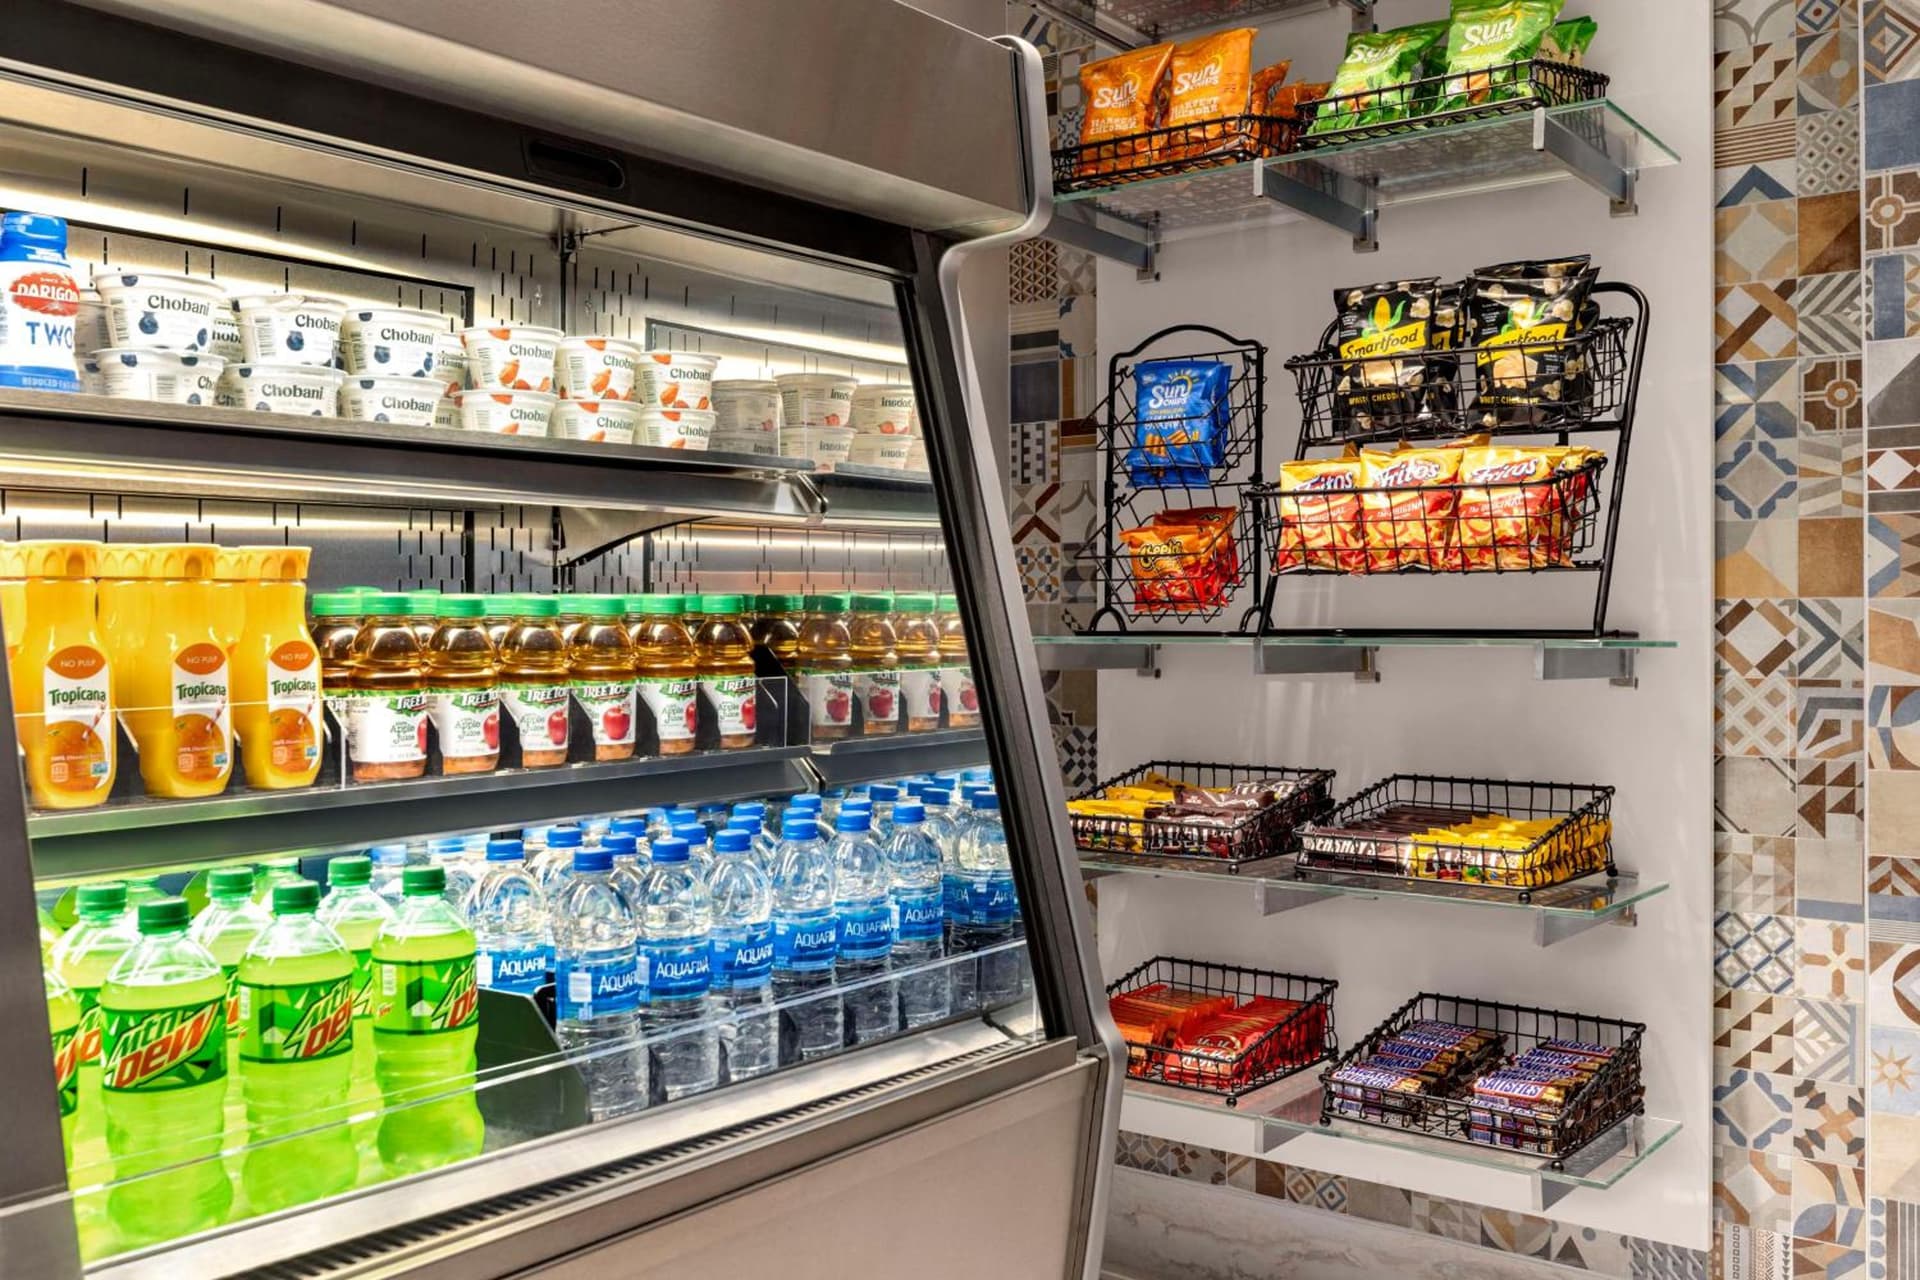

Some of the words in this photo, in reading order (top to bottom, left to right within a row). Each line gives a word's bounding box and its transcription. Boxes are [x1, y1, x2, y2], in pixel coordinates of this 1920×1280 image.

[1462, 18, 1515, 51] Sun
[1173, 61, 1222, 95] Sun
[1093, 80, 1139, 108] Sun
[16, 284, 80, 302] DARIGO
[147, 294, 210, 316] Chobani
[294, 313, 340, 332] Choba
[380, 327, 435, 346] Chobani
[1344, 328, 1419, 360] Smartfood
[602, 354, 635, 369] Choba
[261, 383, 324, 401] Chobani
[1148, 382, 1190, 409] Sun
[1371, 391, 1406, 403] CHEDDR
[381, 395, 435, 413] Chobani
[509, 407, 548, 423] Choba
[596, 416, 635, 431] Choban
[1373, 459, 1441, 488] Fritos
[1471, 457, 1539, 483] Fritos
[61, 659, 75, 668] NO
[78, 659, 96, 667] PULP
[48, 685, 107, 706] Tropicana
[176, 681, 227, 701] Tropicana
[271, 677, 316, 696] Tropicana
[527, 688, 553, 702] TREE
[582, 687, 608, 699] TREE
[389, 722, 416, 736] Apple
[455, 719, 481, 733] Apple
[734, 942, 774, 967] AQUAF
[655, 955, 711, 980] AQUAFINA
[301, 996, 352, 1058] DE
[106, 1009, 176, 1068] Mtn
[1381, 1040, 1439, 1062] SNICKERS
[1477, 1077, 1542, 1097] SATISFIES
